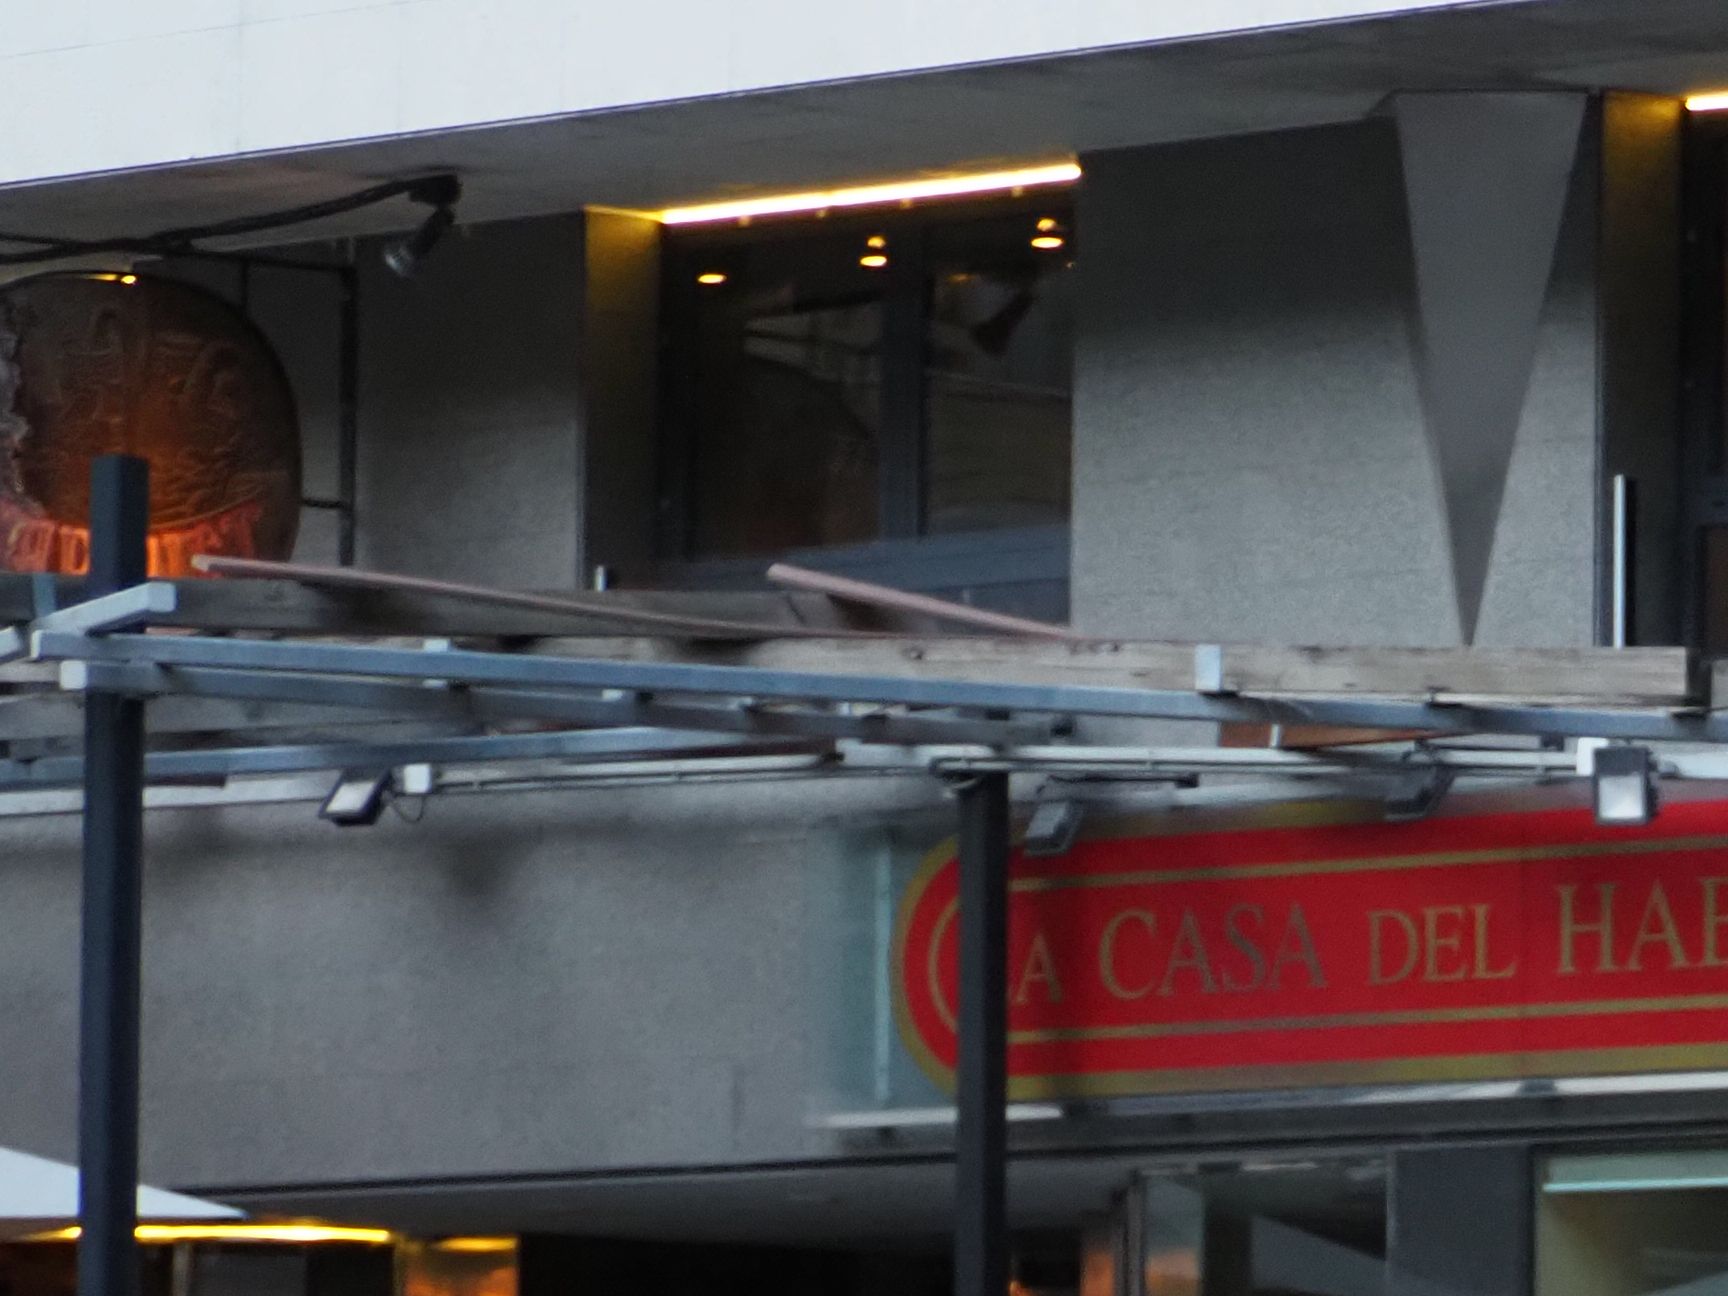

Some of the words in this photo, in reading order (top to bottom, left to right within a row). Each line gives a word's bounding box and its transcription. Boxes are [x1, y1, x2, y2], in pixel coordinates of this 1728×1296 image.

[1016, 935, 1063, 1005] A
[1101, 902, 1326, 1000] CASA
[1366, 902, 1518, 988] DEL
